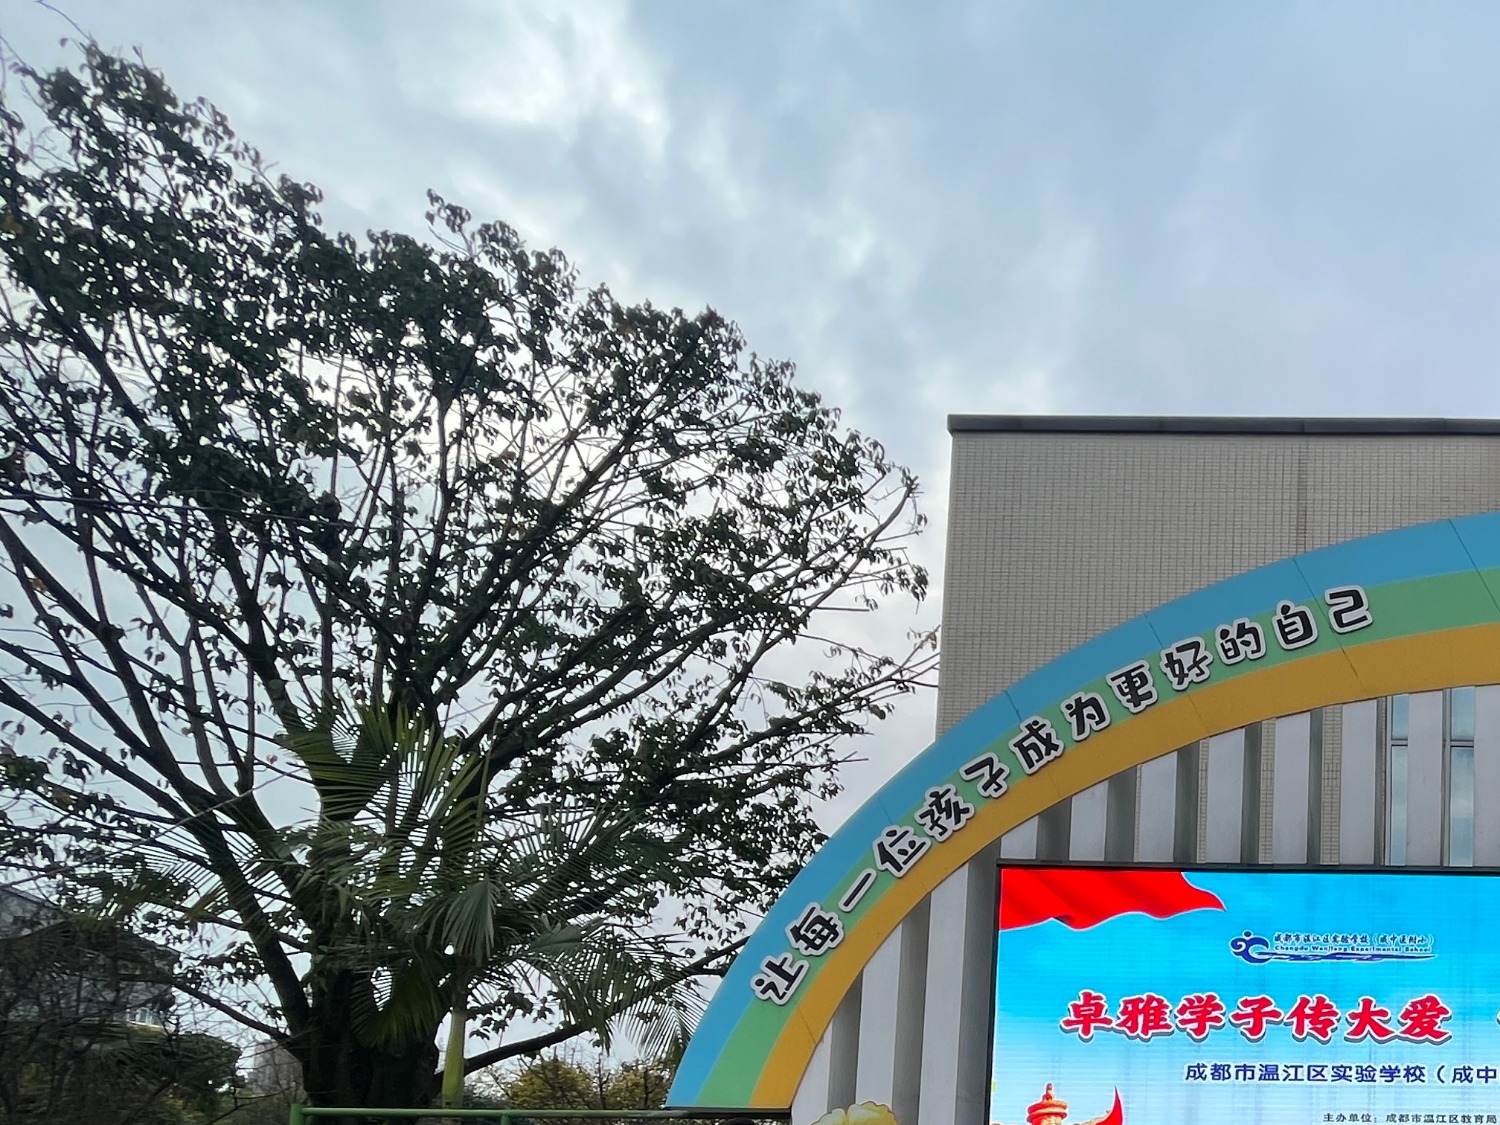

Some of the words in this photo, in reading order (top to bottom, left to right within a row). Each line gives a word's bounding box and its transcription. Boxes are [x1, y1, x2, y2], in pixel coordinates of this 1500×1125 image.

[752, 586, 1372, 1004] 让每一位孩子成为更好的自己
[1061, 991, 1452, 1044] 卓雅学子传大爱
